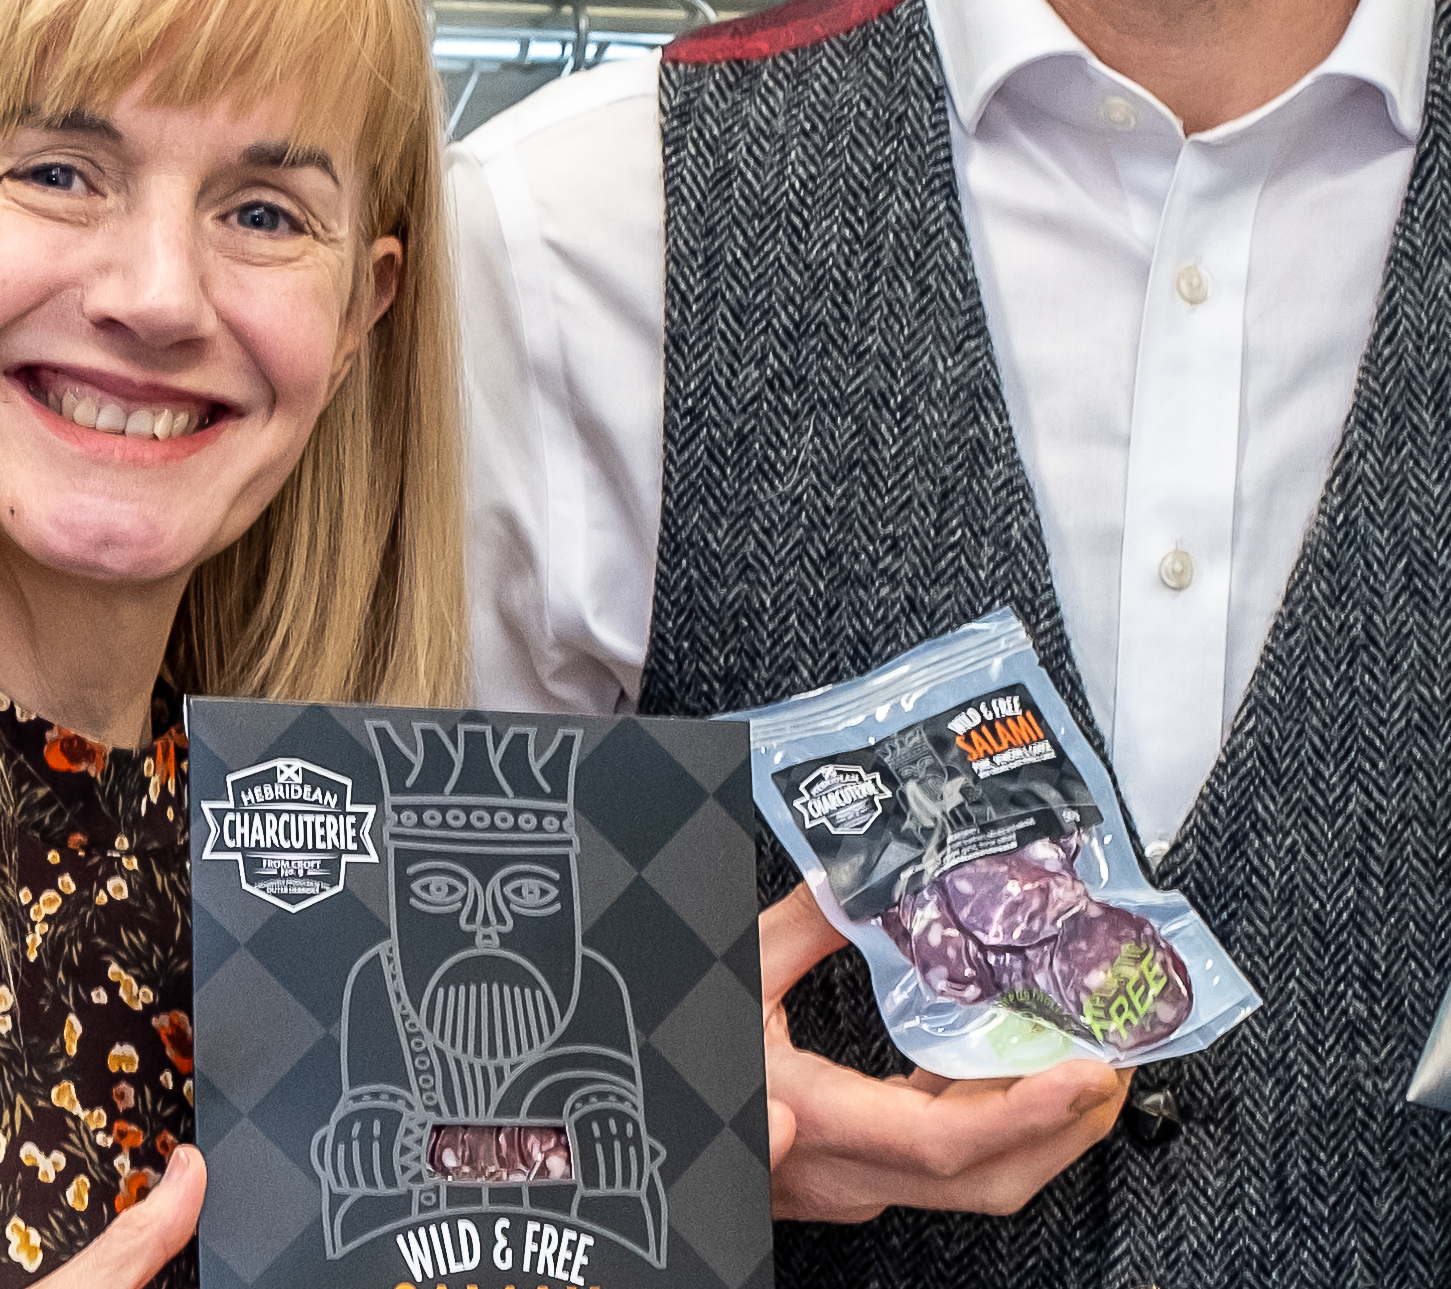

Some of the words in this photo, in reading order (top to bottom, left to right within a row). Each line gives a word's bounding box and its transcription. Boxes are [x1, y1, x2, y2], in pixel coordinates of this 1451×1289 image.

[955, 709, 1045, 762] SALAMI
[240, 782, 338, 809] HEBRIDEAN
[222, 811, 358, 851] CHARCUTERIE
[396, 1218, 482, 1283] WILD
[493, 1217, 513, 1271] &
[522, 1219, 595, 1287] FREE
